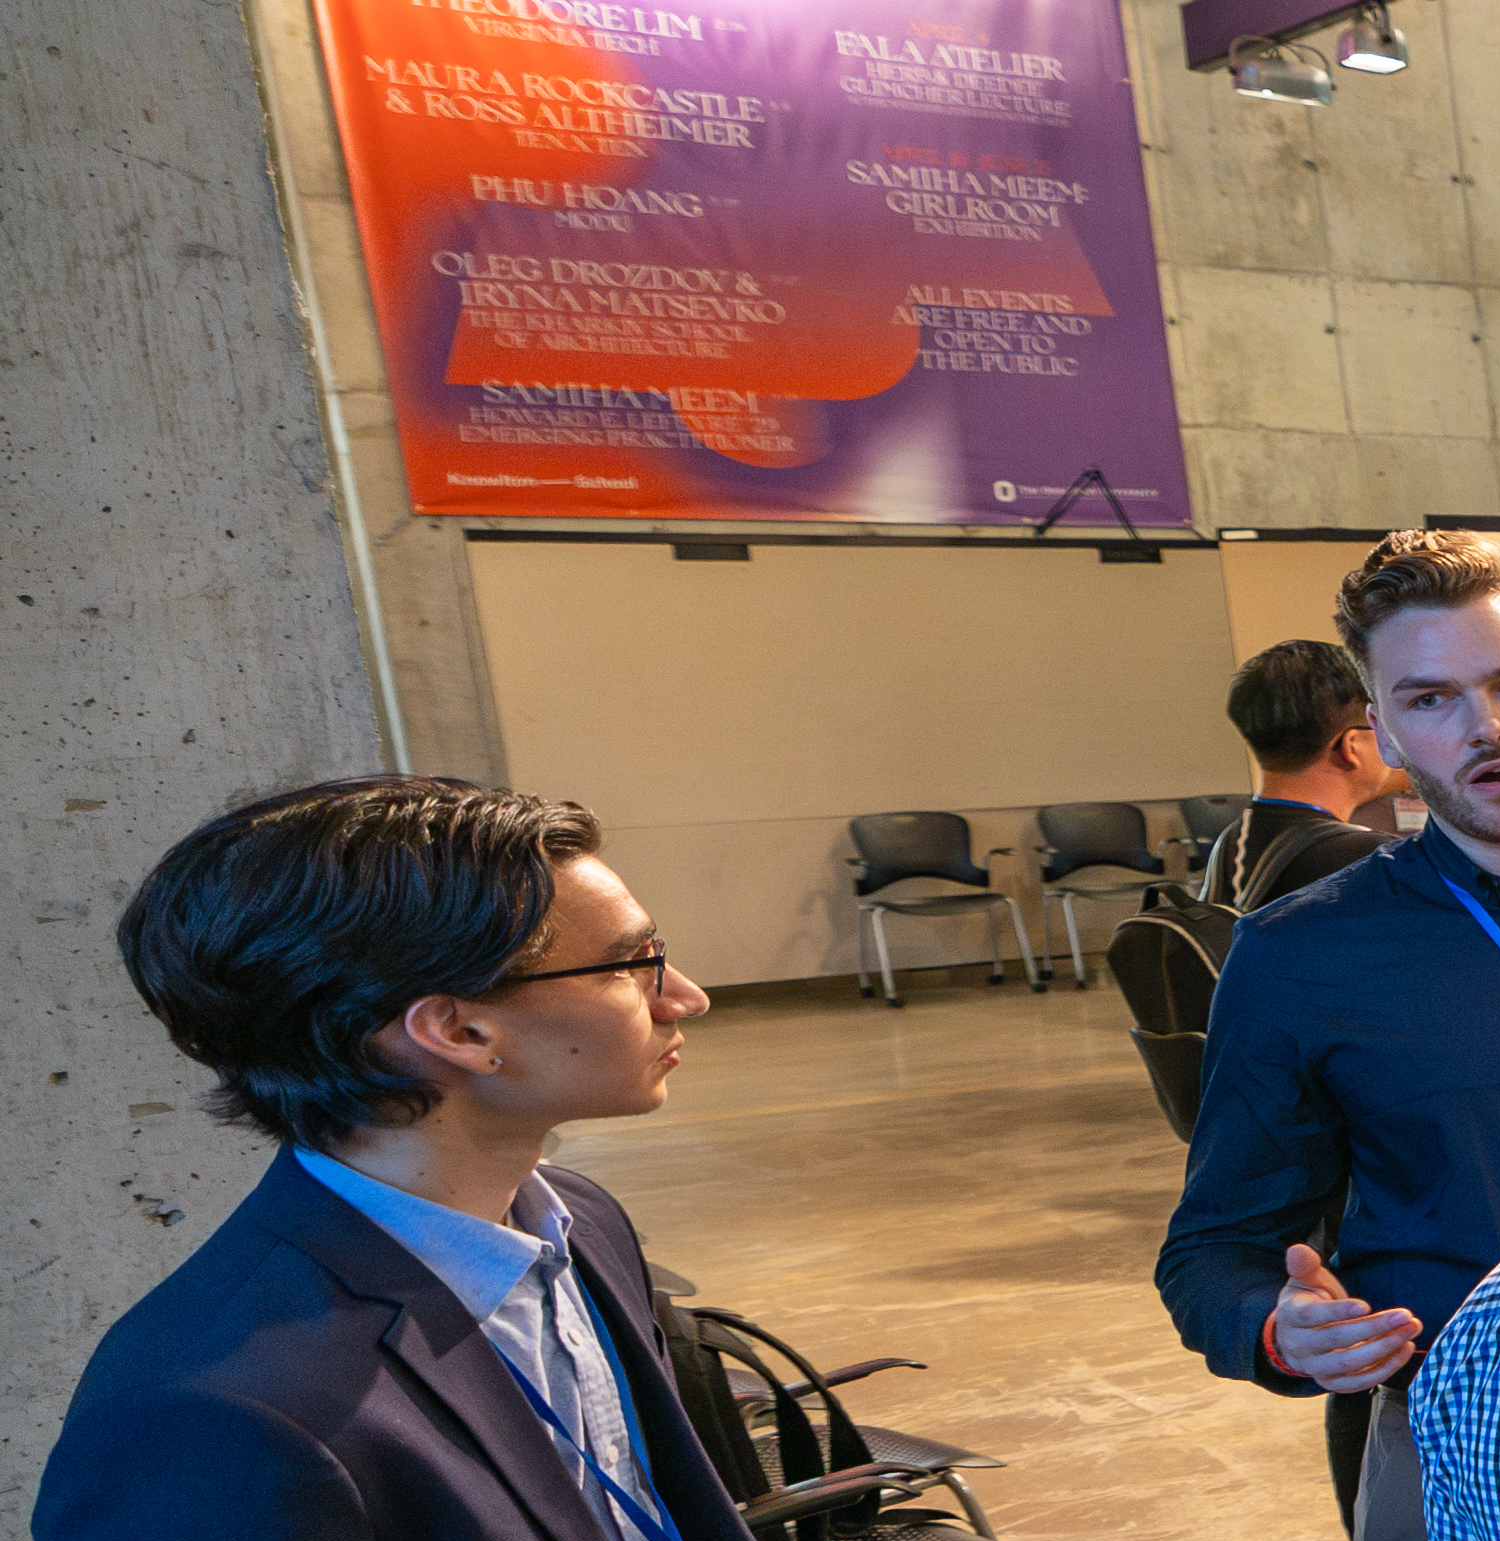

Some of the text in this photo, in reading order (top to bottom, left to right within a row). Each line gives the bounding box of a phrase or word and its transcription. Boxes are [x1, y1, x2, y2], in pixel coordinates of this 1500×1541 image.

[463, 14, 662, 57] VIRGINIA TECH
[631, 8, 705, 42] LIM
[930, 43, 1067, 83] ATELIER
[363, 55, 766, 123] MAURA ROCKCASTLE
[386, 88, 755, 149] & ROSS ALTHEIMER
[470, 174, 704, 218] PHU HOANG
[846, 159, 986, 197] SAMIHA
[886, 190, 1060, 228] GIRLROOM
[431, 250, 763, 297] OLEG DROZDOV &
[458, 279, 788, 325] IRYNA MATSEVKO
[904, 285, 1076, 313] ALL EVENTS
[892, 304, 1093, 336] ARE FREE AND
[933, 329, 1057, 355] OPEN TO
[918, 348, 1079, 377] THE PUBLIC
[481, 378, 760, 414] SAMIHA MEEM
